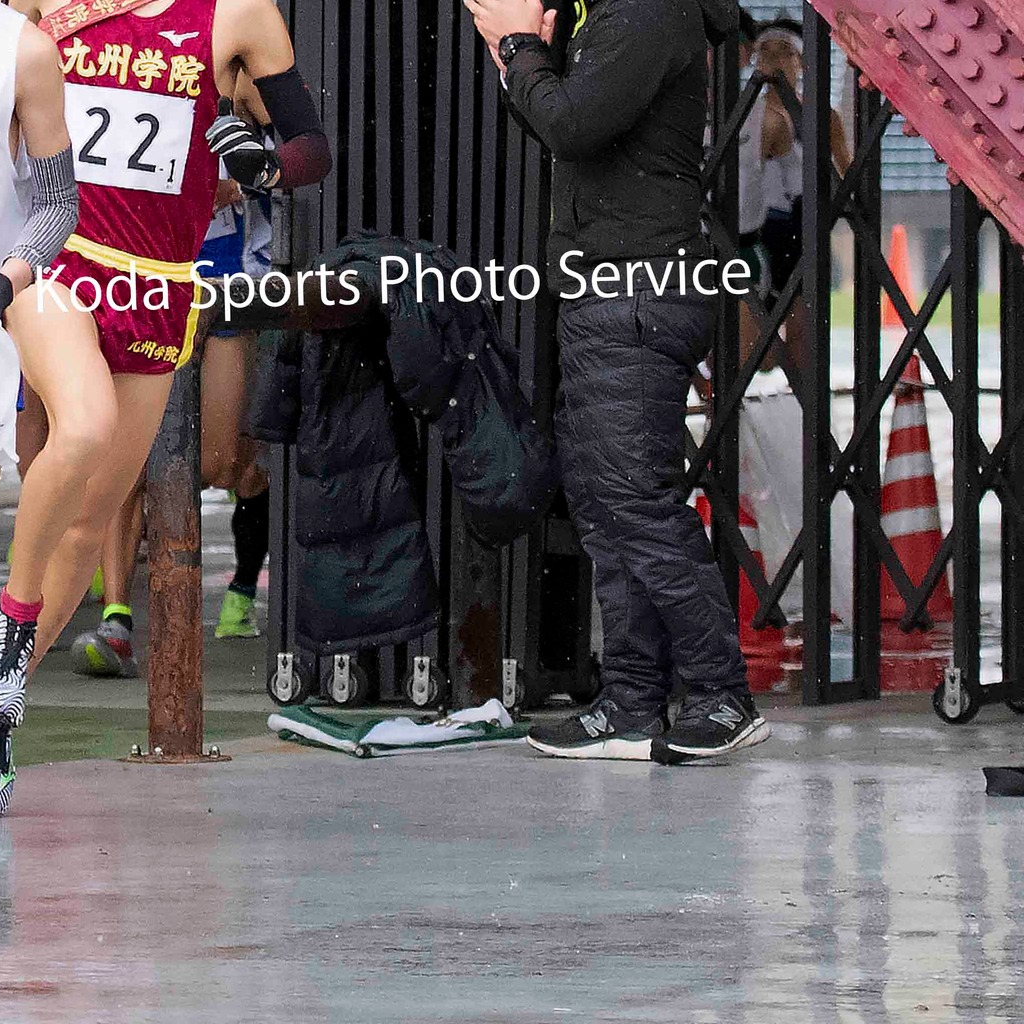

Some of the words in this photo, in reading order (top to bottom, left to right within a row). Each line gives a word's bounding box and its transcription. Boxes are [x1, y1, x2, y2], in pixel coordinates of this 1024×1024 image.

[60, 36, 207, 98] 九州学院
[78, 106, 161, 173] 22
[126, 339, 180, 364] 九州学院
